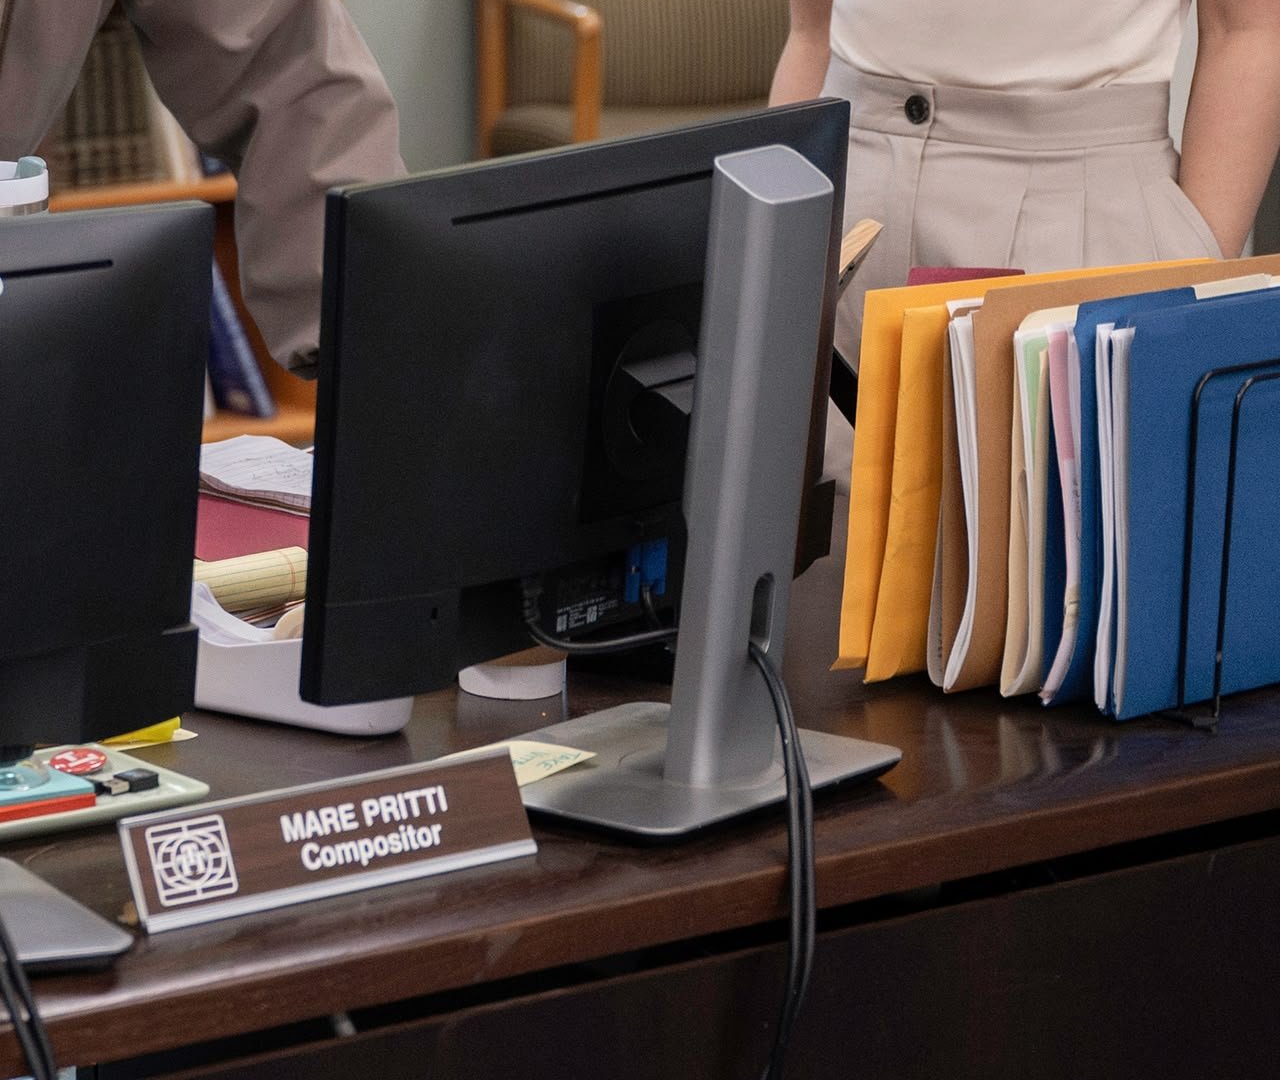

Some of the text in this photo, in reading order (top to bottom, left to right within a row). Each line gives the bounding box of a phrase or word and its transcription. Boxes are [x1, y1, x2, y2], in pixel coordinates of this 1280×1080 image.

[280, 785, 448, 843] MARE PRITTI
[301, 823, 442, 871] Compositor
